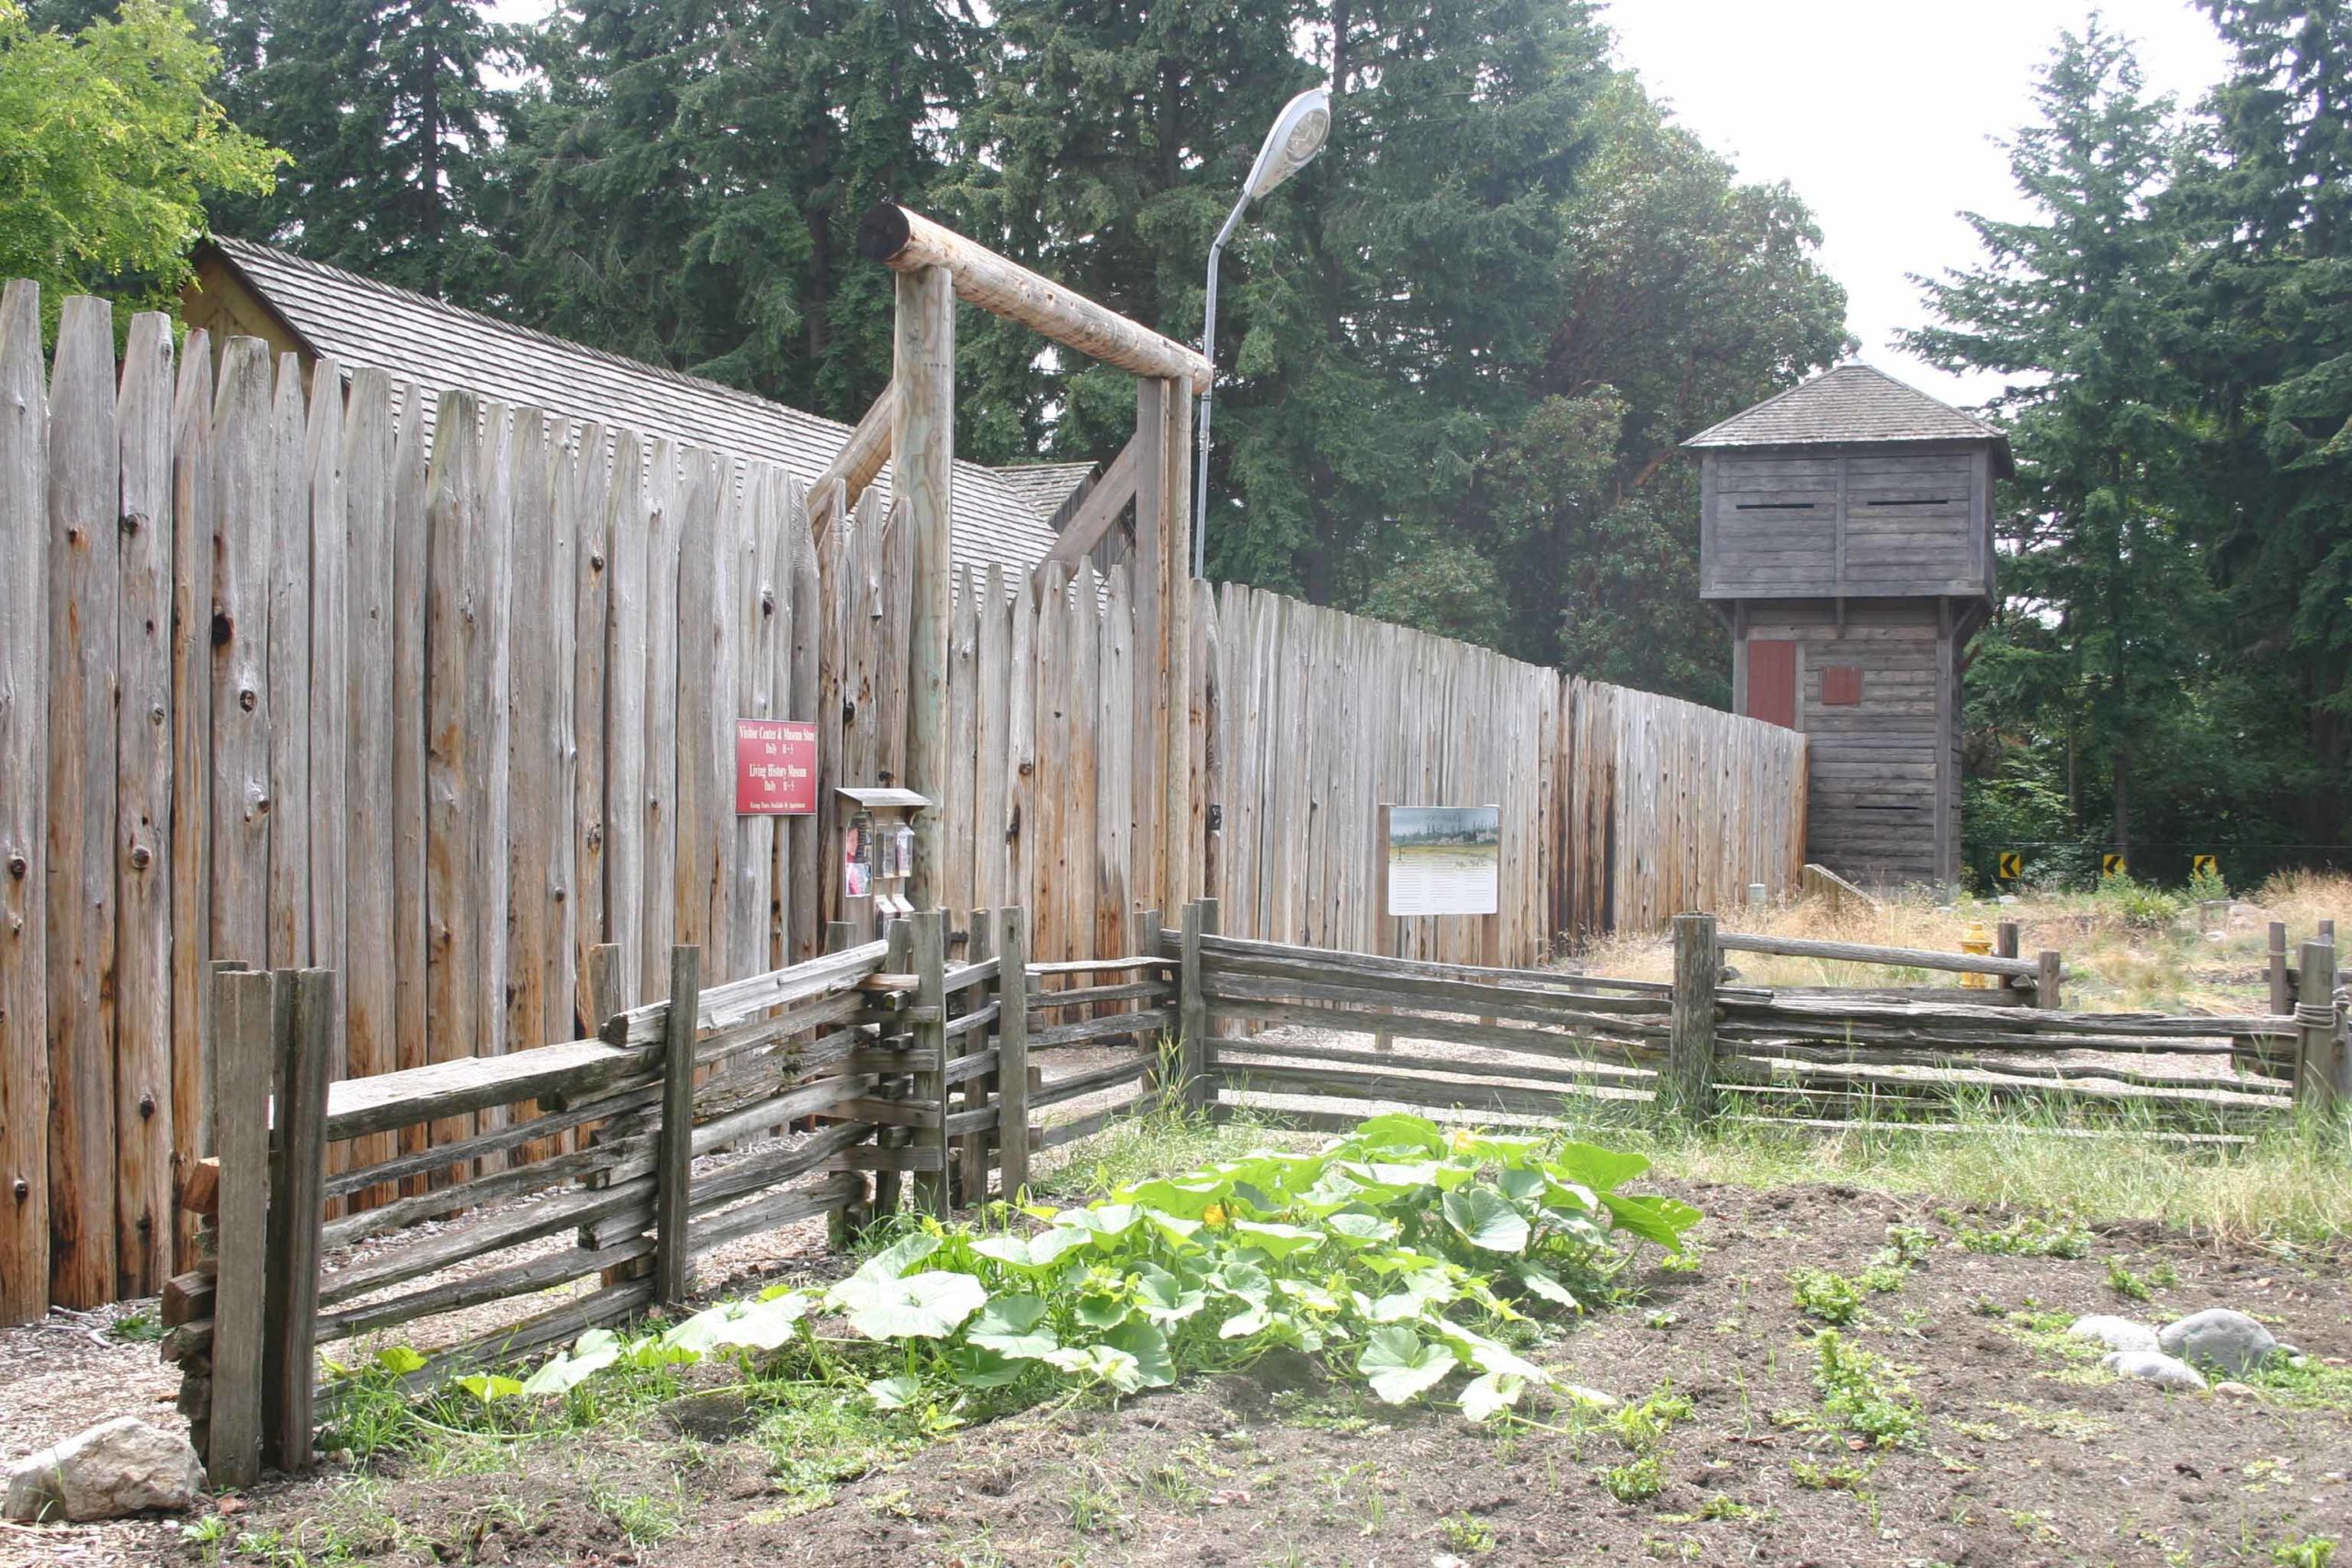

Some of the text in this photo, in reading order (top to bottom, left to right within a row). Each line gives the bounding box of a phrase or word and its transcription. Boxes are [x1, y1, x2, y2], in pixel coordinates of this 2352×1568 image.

[739, 726, 815, 742] Visitor Center & Museum Store
[749, 763, 807, 780] Living History Museum
